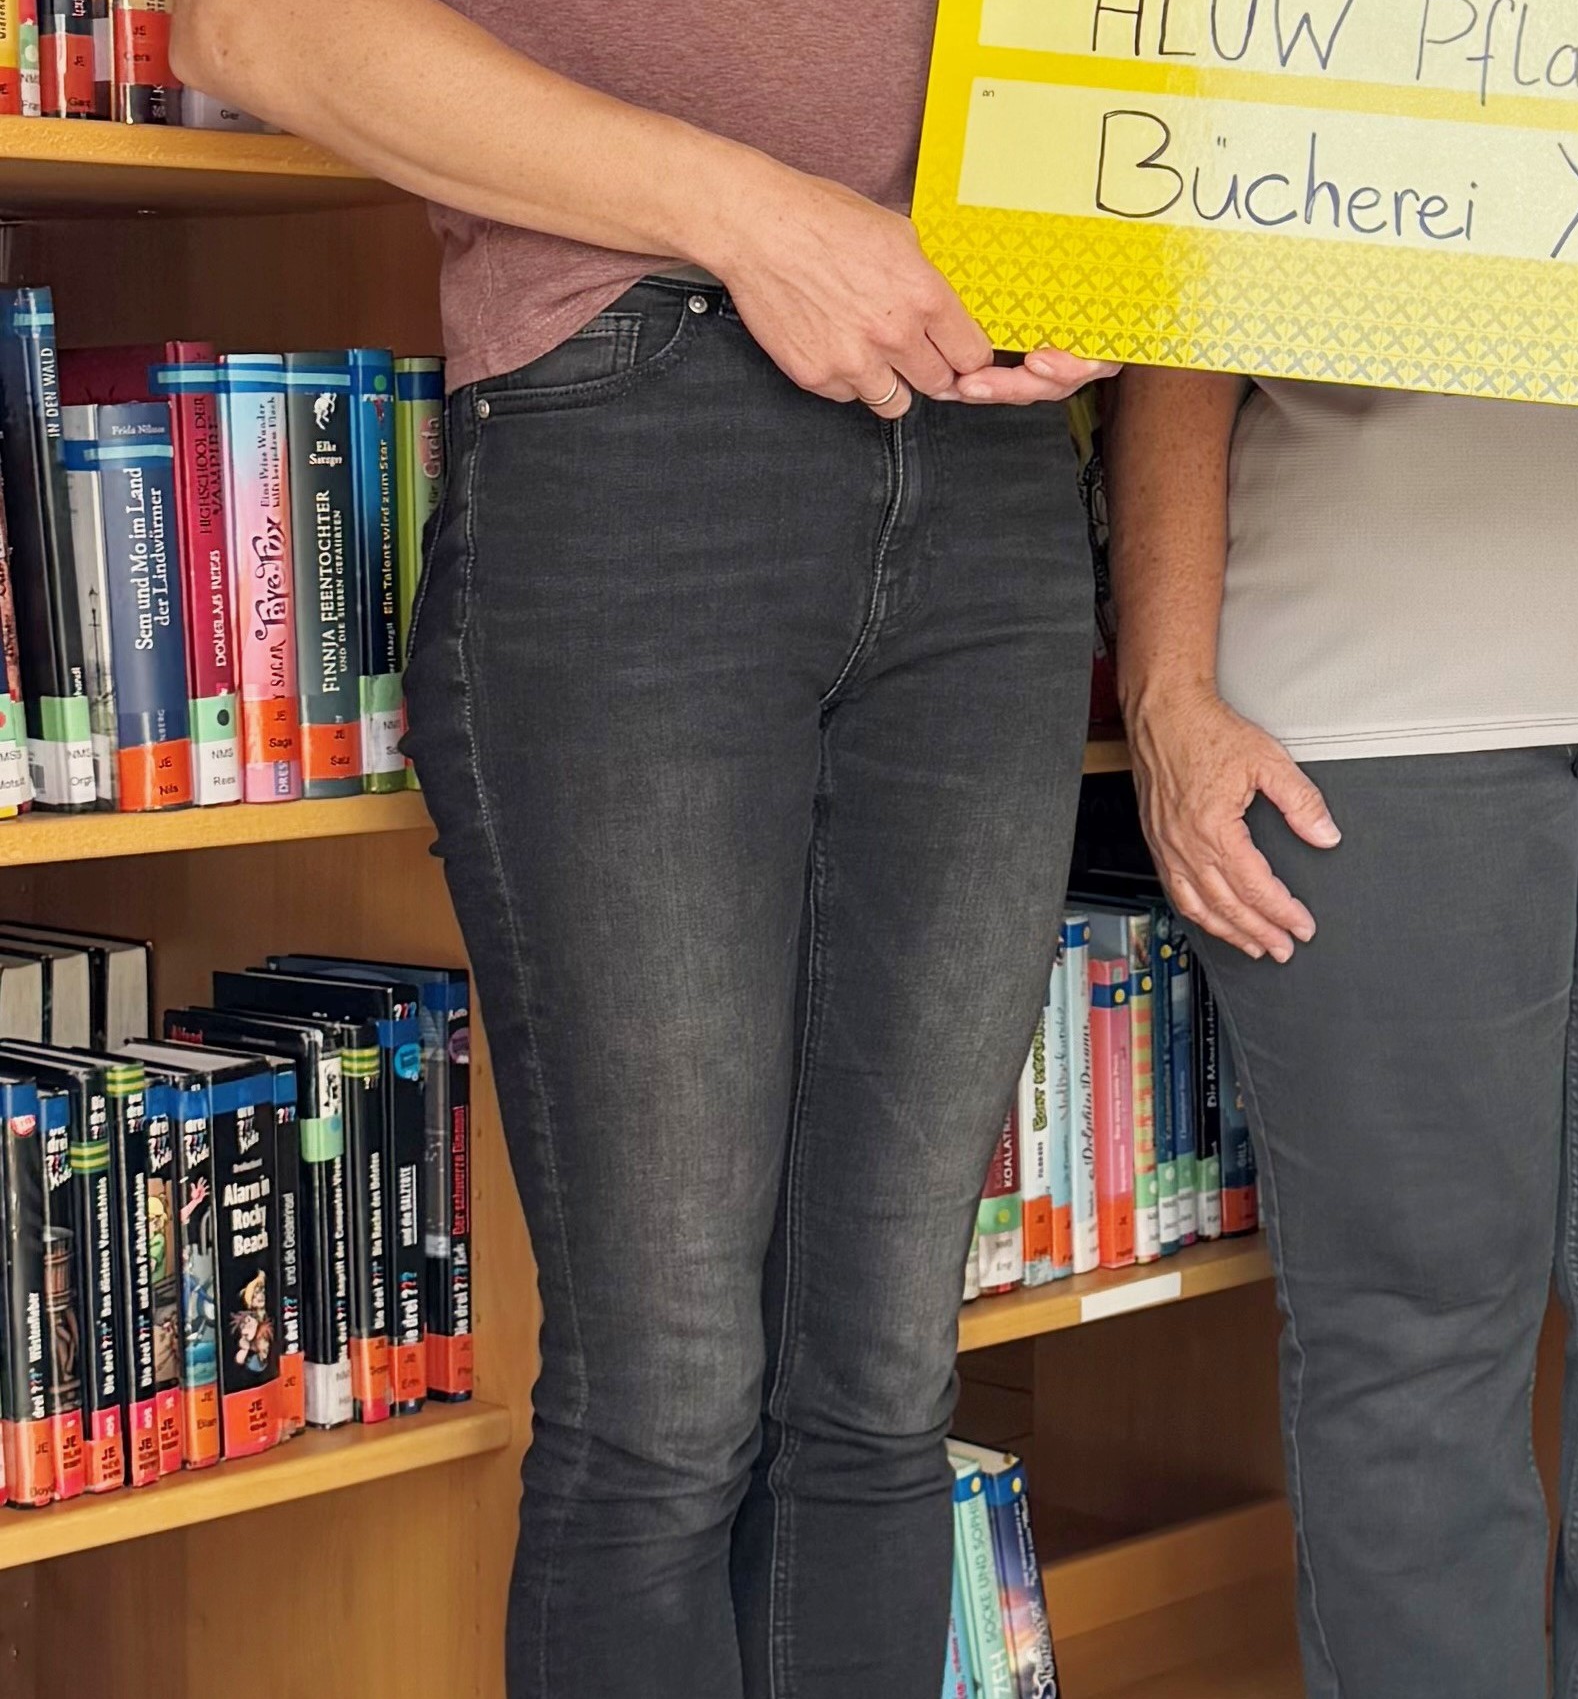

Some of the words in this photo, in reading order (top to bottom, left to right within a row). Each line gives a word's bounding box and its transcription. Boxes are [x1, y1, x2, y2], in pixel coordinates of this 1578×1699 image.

[1095, 107, 1480, 243] Bücherei
[40, 346, 56, 387] WALD
[43, 390, 59, 418] DEN
[378, 438, 390, 470] Star
[123, 467, 144, 514] Land
[380, 472, 390, 504] zum
[129, 516, 146, 538] im
[148, 487, 169, 595] Lindwürmer
[380, 506, 392, 540] wird
[130, 542, 149, 573] Mo
[316, 489, 339, 622] FEENTOCHTER
[381, 543, 393, 590] Talent
[133, 575, 151, 609] und
[155, 598, 171, 626] der
[134, 612, 155, 650] Sem
[321, 628, 341, 693] FINNJA
